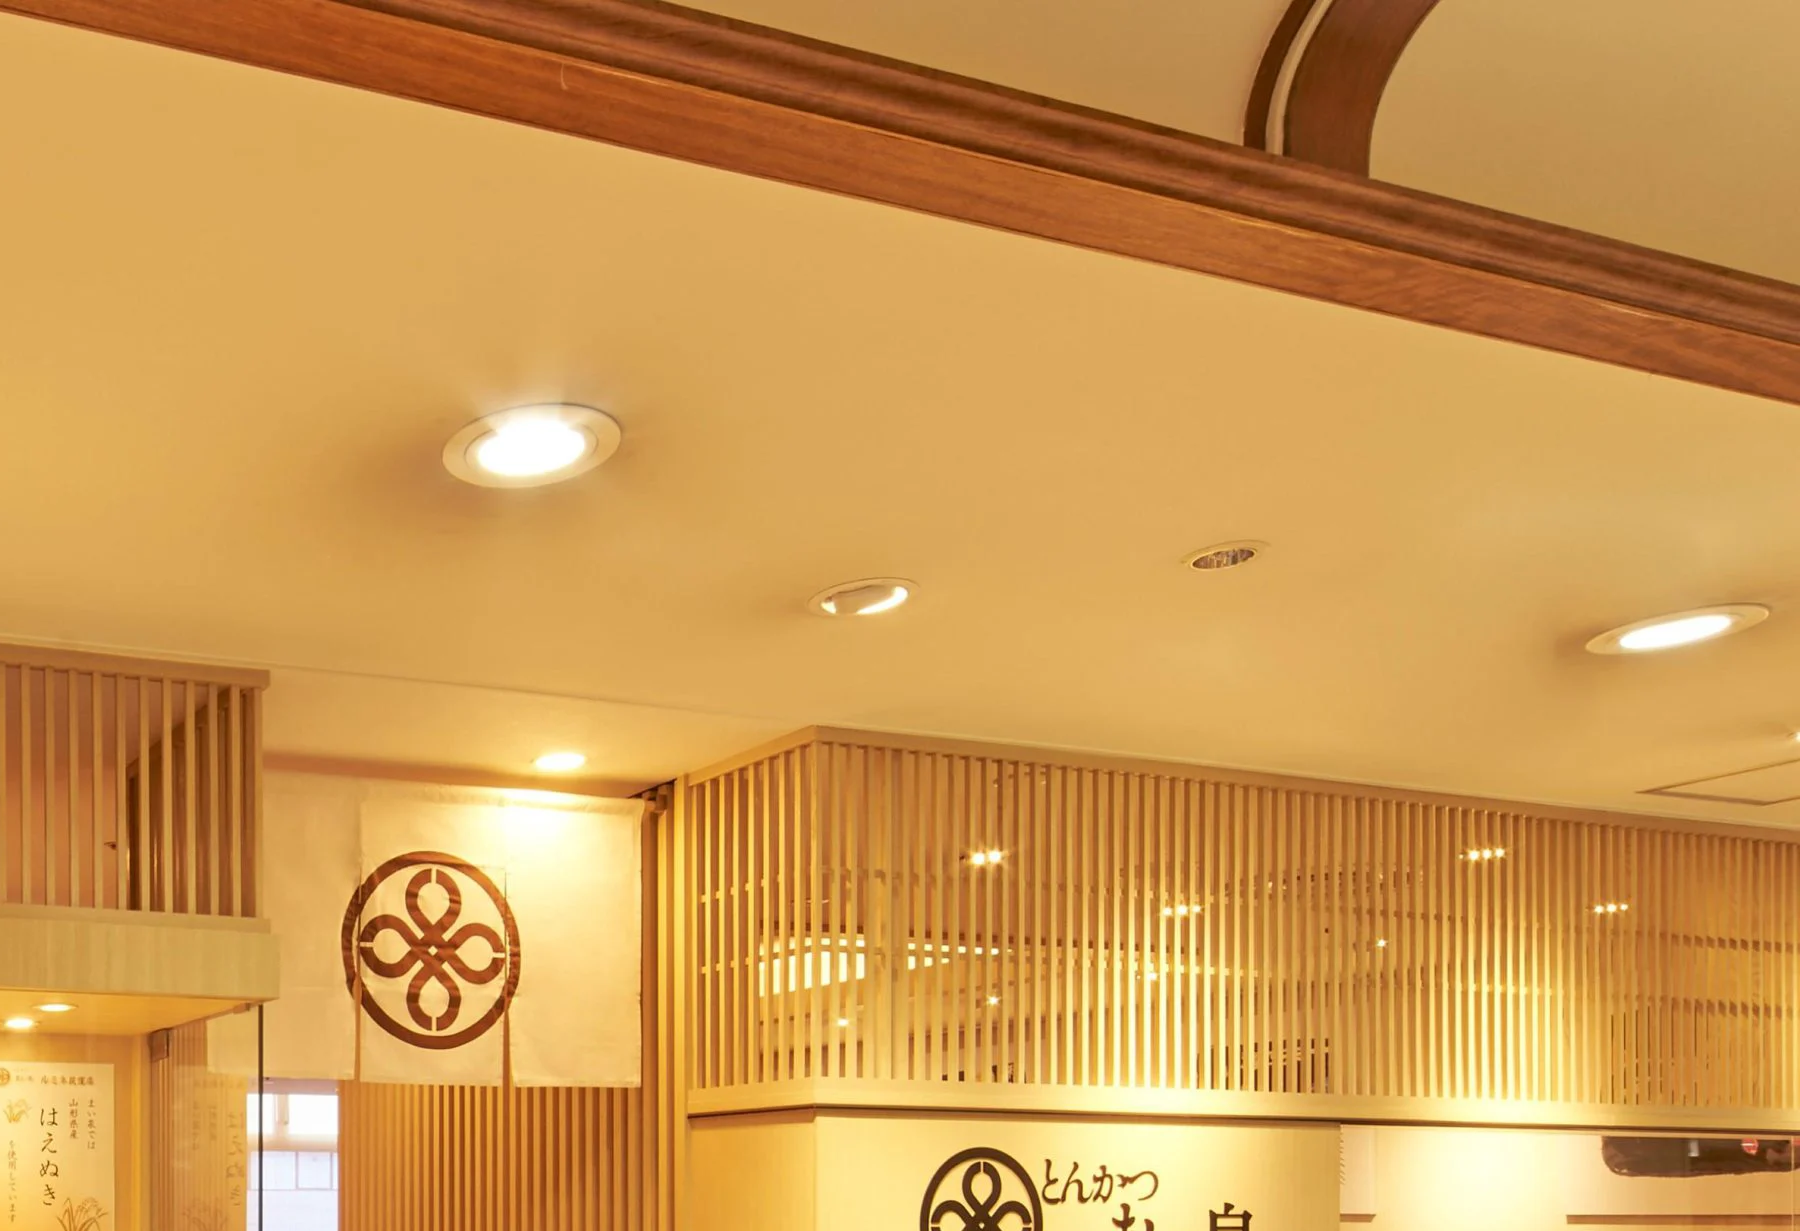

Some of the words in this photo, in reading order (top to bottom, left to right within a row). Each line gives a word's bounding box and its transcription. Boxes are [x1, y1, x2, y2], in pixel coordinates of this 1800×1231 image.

[68, 1098, 80, 1140] 山形県産
[7, 1139, 18, 1223] を使用しています
[39, 1107, 59, 1206] はえぬき
[1040, 1158, 1160, 1204] とんかつ
